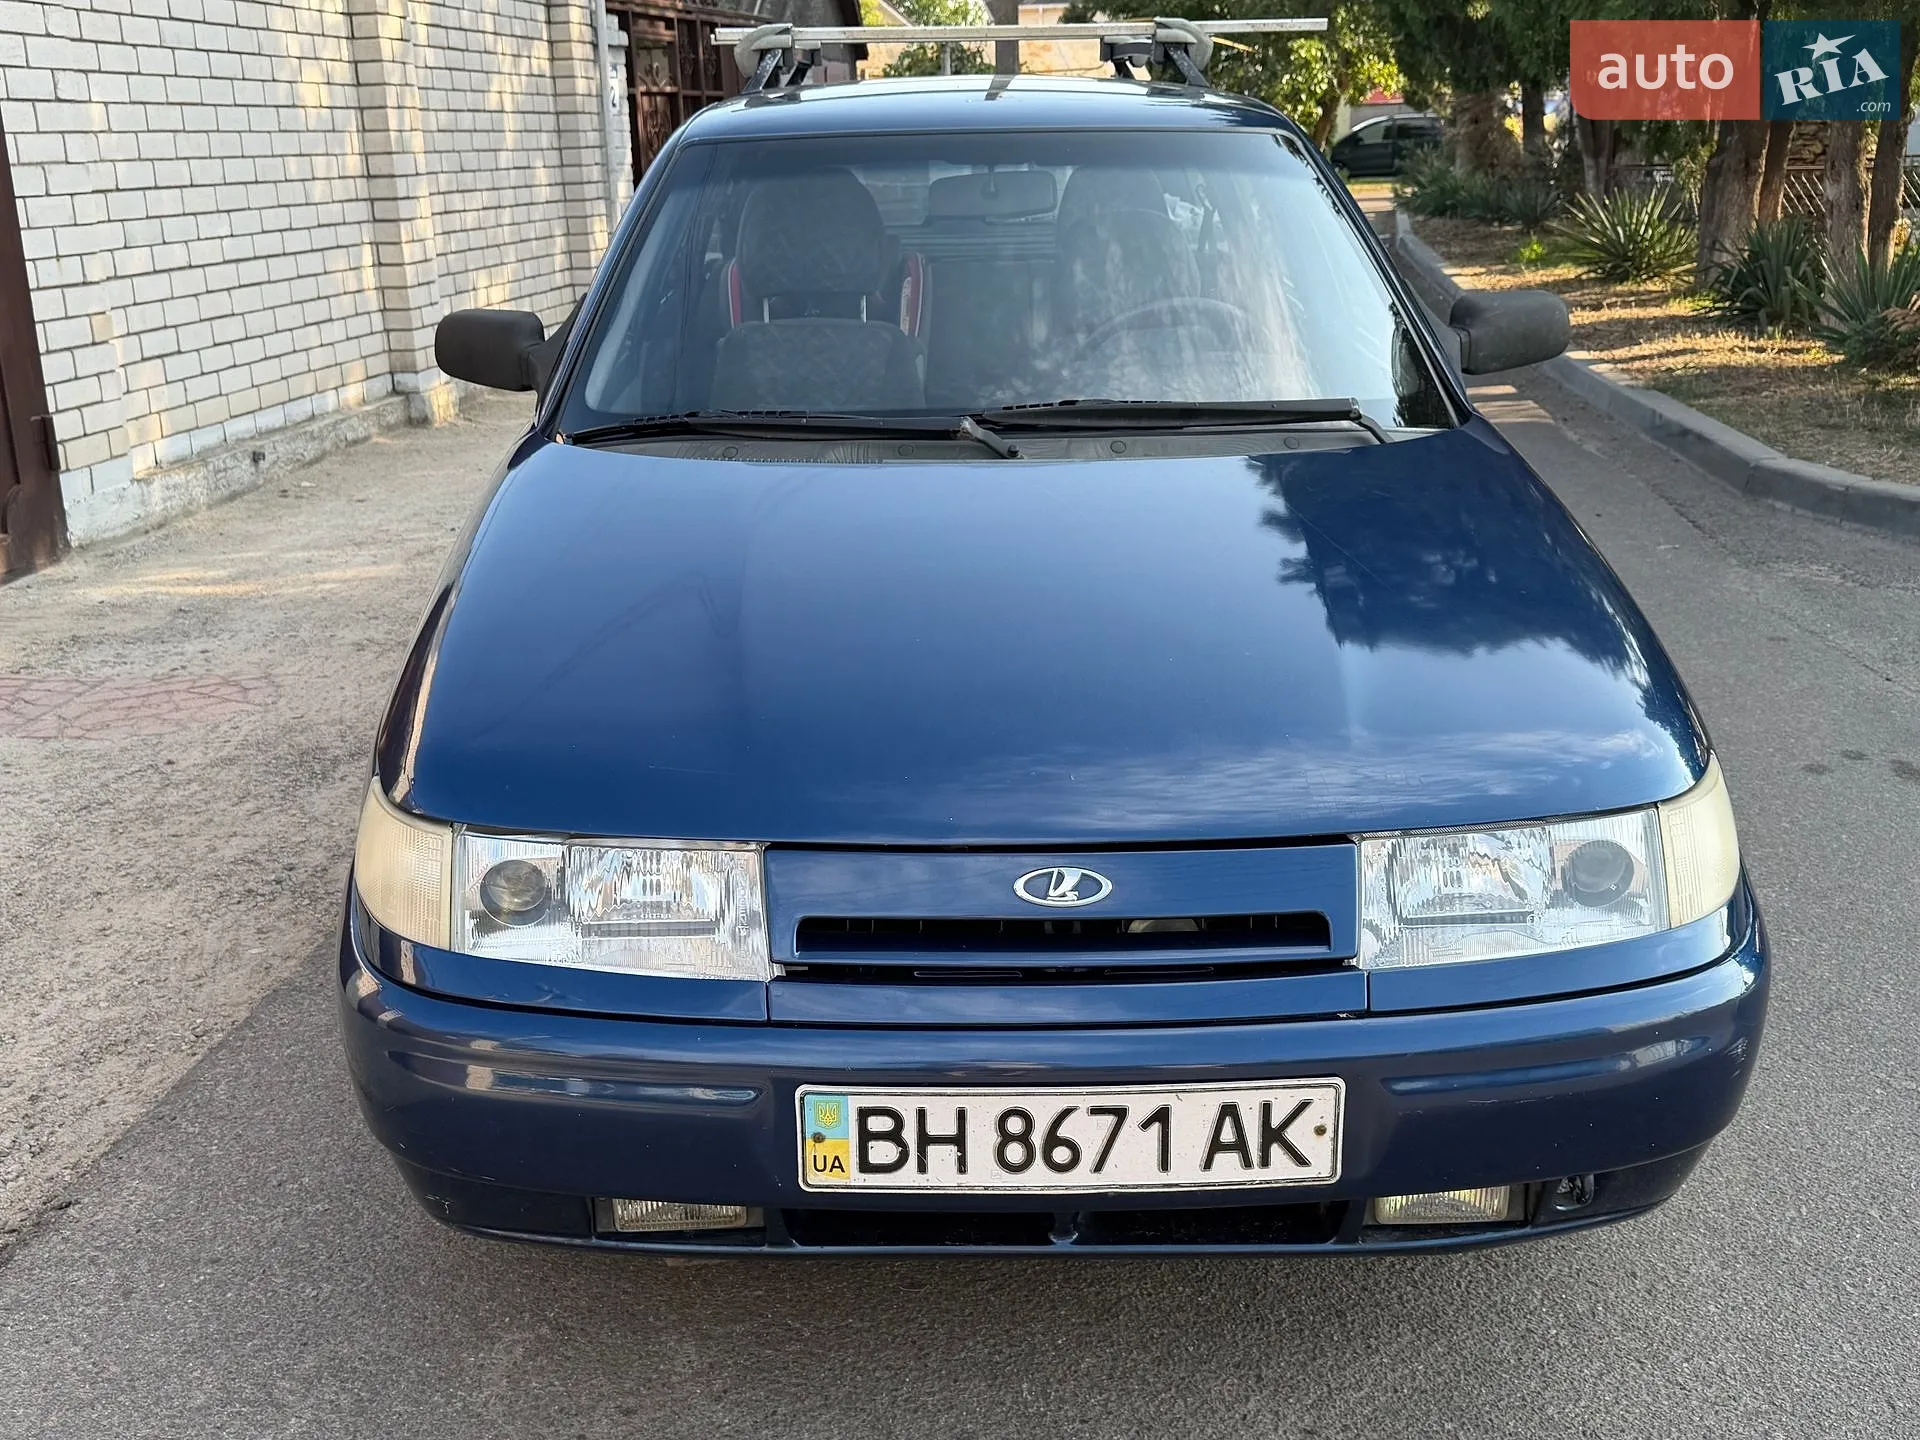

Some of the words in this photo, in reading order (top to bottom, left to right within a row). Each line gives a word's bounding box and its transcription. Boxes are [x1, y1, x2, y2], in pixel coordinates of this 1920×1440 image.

[857, 1106, 967, 1174] BH
[995, 1105, 1173, 1174] 8671
[1201, 1099, 1315, 1172] AK
[813, 1153, 846, 1173] UA
